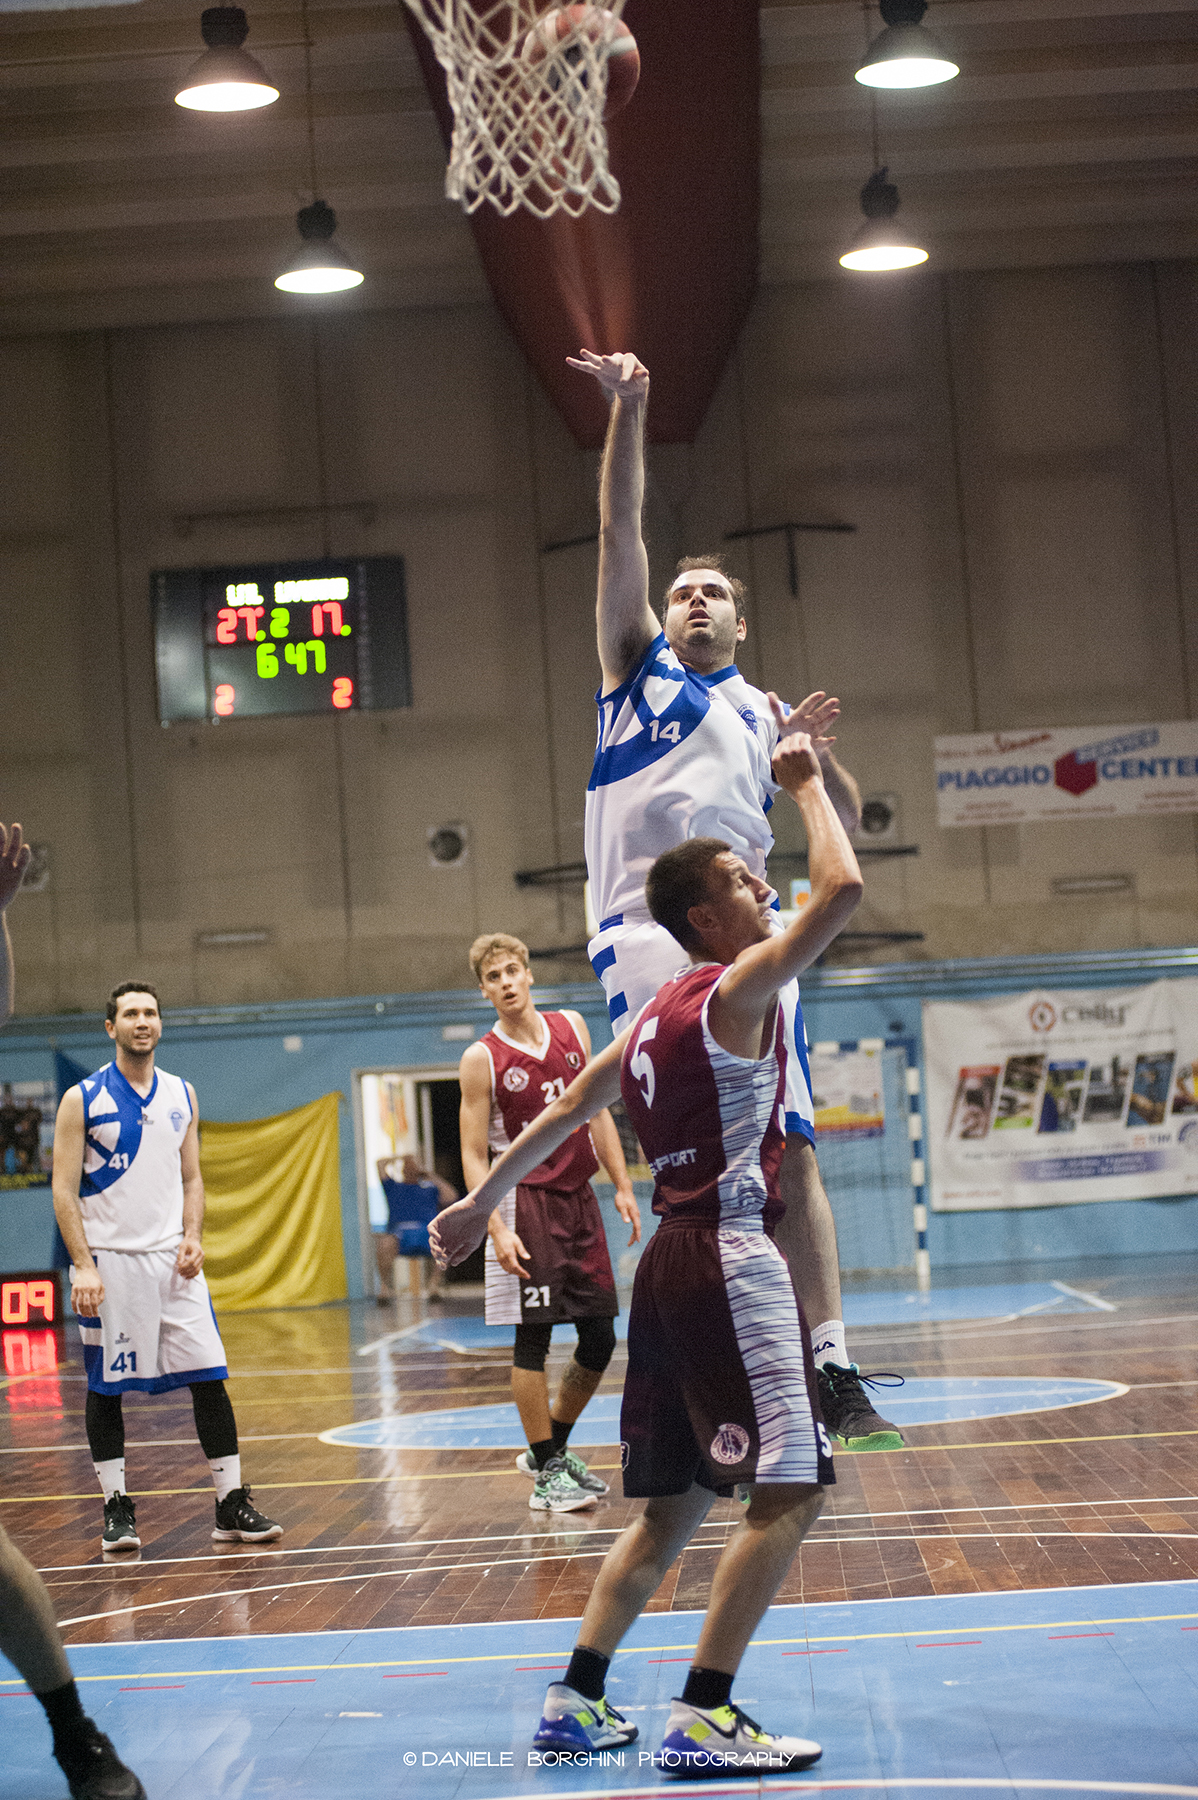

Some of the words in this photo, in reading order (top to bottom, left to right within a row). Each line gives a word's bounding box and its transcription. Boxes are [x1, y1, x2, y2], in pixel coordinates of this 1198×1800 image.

[270, 608, 290, 638] 2
[215, 684, 235, 716] 2
[332, 677, 353, 709] 2
[649, 719, 681, 743] 14
[937, 764, 1051, 791] PIAGGIO
[1102, 756, 1198, 780] CENTE
[630, 1016, 659, 1110] 5
[541, 1077, 566, 1105] 21
[108, 1153, 129, 1169] 41
[2, 1281, 54, 1324] 09
[524, 1286, 550, 1308] 21
[110, 1351, 137, 1373] 41
[814, 1341, 836, 1355] ILA
[816, 1421, 833, 1458] 5
